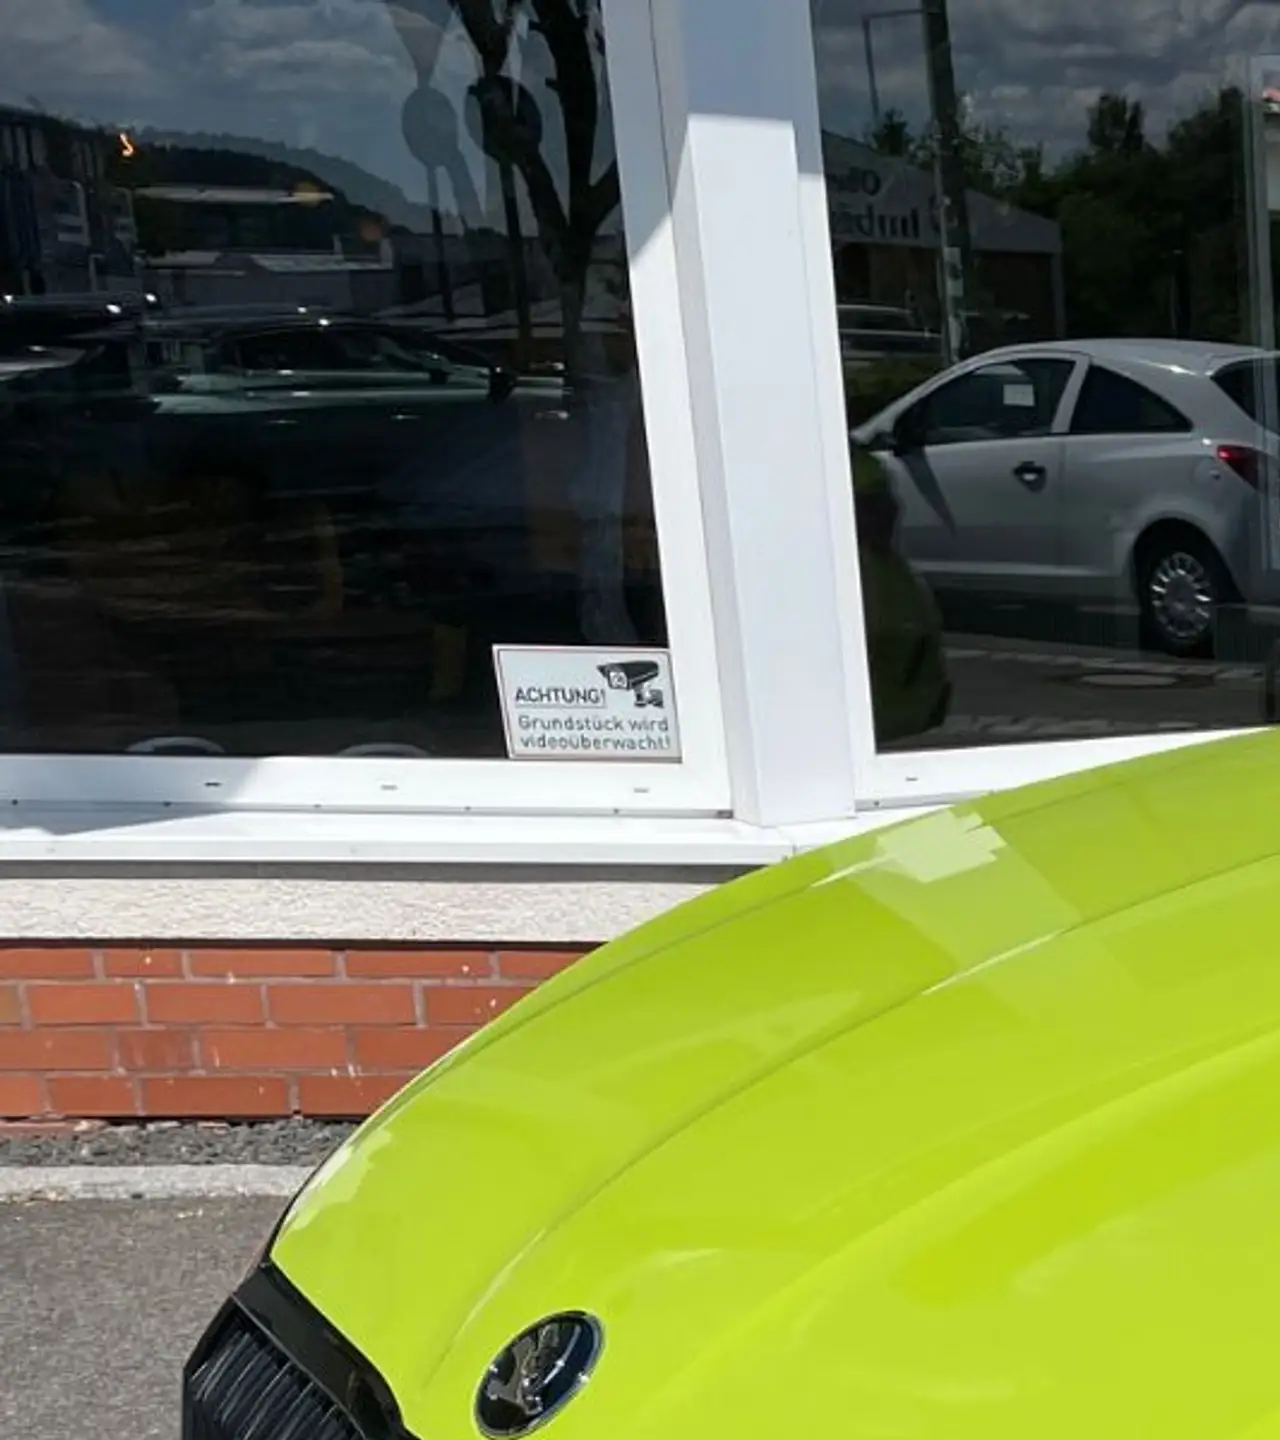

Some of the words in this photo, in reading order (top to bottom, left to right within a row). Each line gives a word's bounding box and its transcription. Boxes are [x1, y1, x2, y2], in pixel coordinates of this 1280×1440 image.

[515, 686, 606, 704] ACHTUNG!
[518, 714, 624, 731] Grundstück
[628, 715, 669, 731] wird
[520, 733, 670, 750] videoüberwacht!
